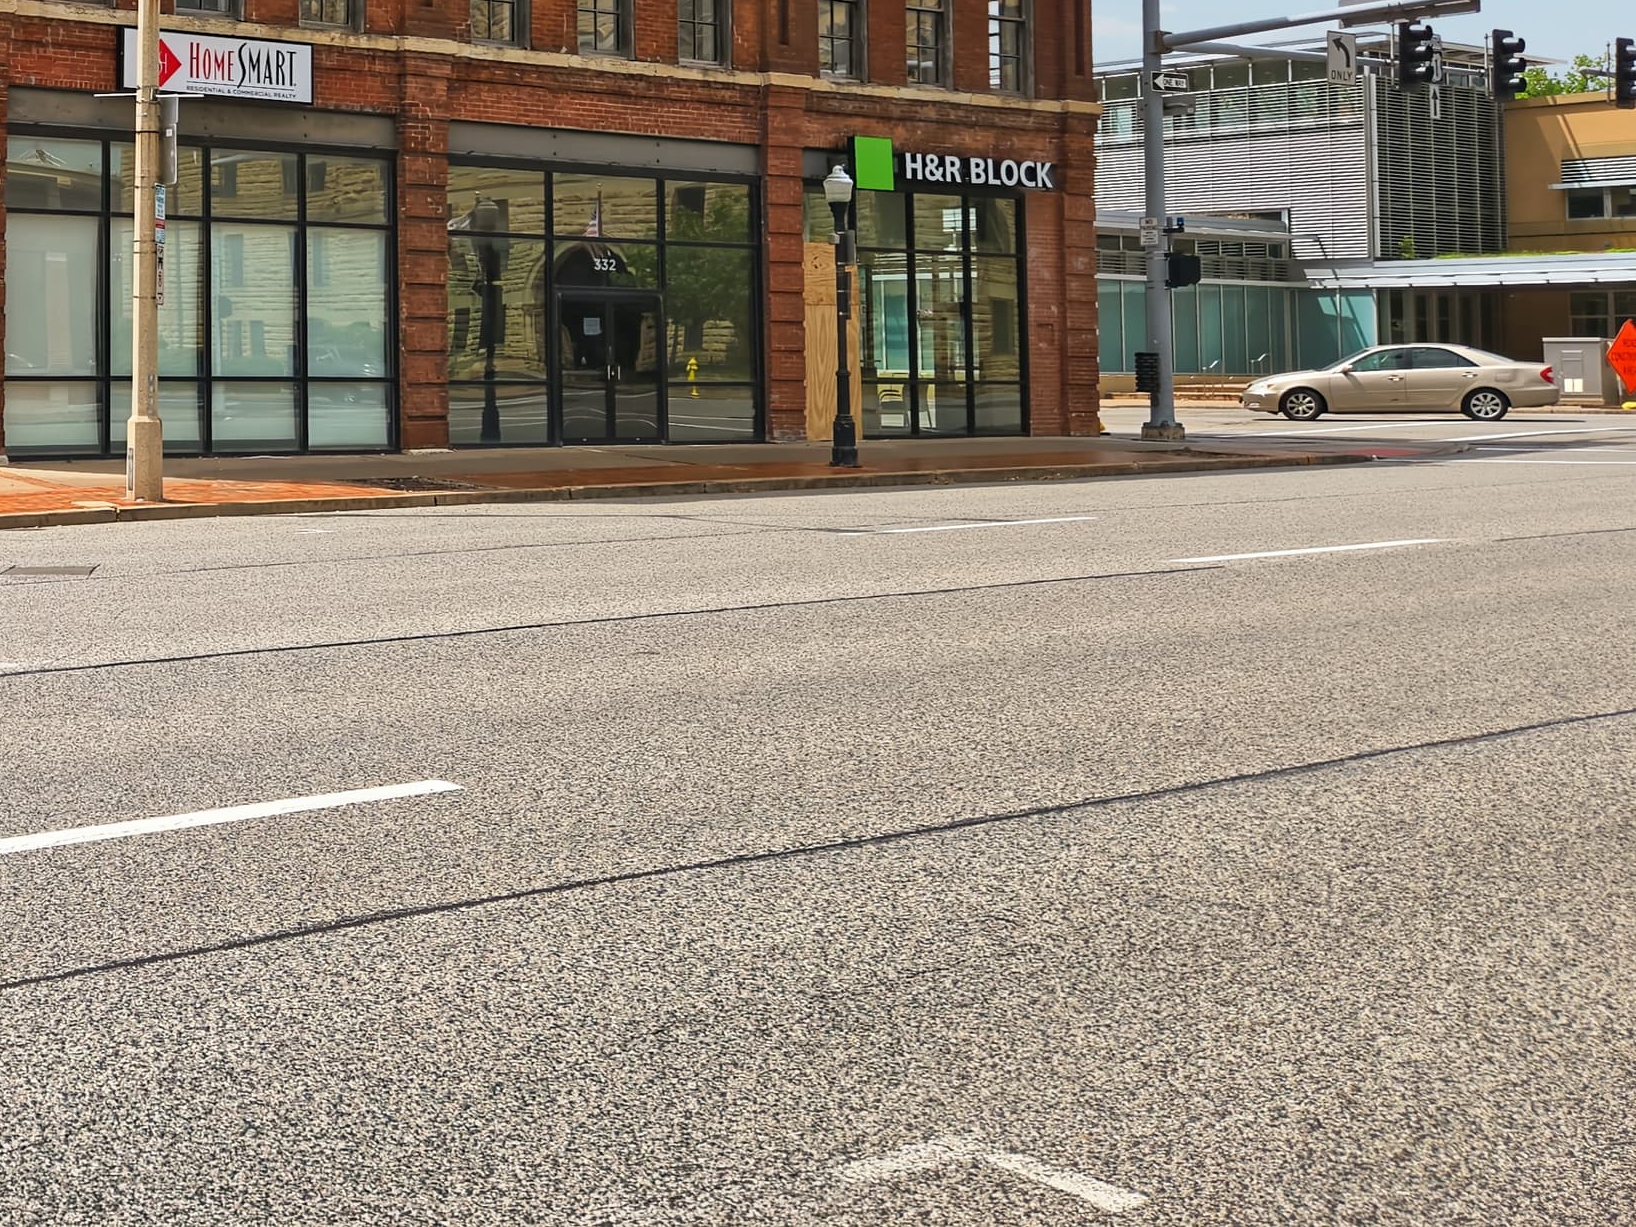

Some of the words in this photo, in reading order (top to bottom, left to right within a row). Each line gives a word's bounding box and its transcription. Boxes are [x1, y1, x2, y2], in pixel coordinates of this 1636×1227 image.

[1331, 69, 1353, 81] ONLY
[1164, 78, 1173, 86] ONE
[186, 85, 225, 94] RESIDENTIAL
[232, 89, 272, 98] COMMERCIAL
[905, 152, 962, 183] H&R
[970, 157, 1053, 188] BLOCK
[594, 258, 617, 271] 332
